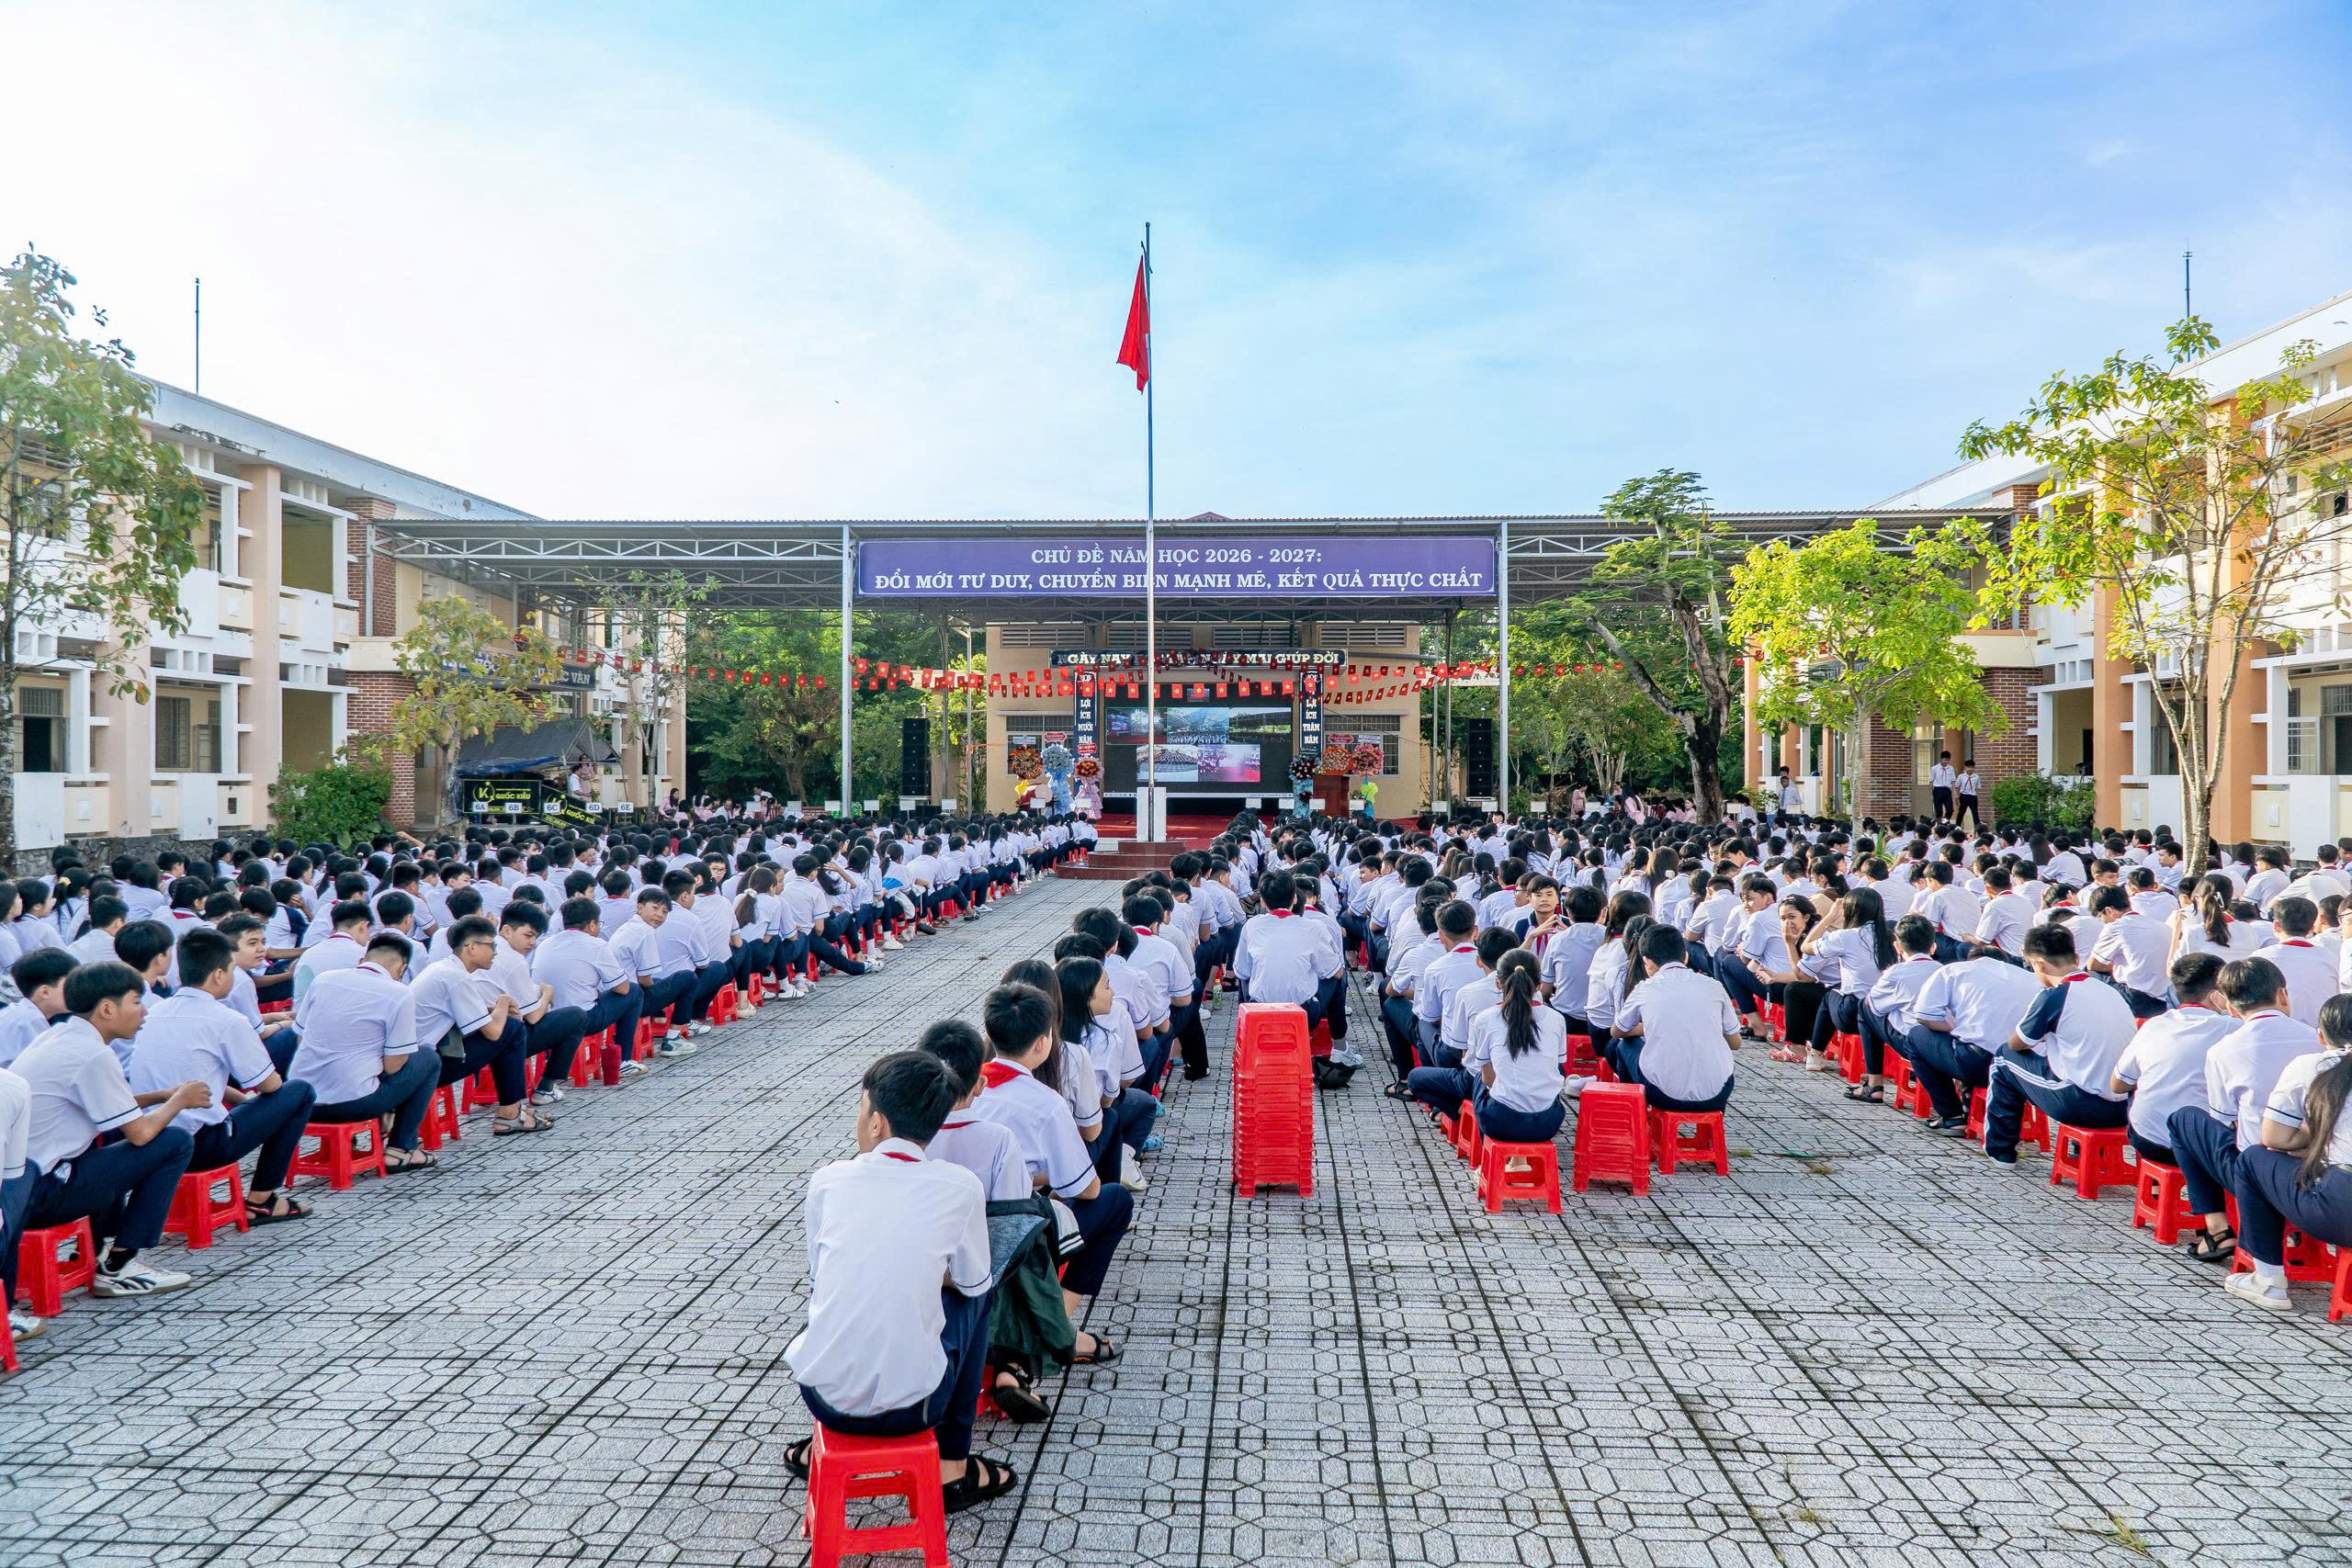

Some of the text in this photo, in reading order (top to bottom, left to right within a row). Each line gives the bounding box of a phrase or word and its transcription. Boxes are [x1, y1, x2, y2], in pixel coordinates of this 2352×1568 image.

[1031, 545, 1071, 563] CHỦ
[1077, 542, 1104, 563] ĐỀ
[1110, 546, 1148, 563] NĂM
[1158, 548, 1199, 567] HỌC
[1205, 548, 1252, 563] 2026
[1270, 548, 1322, 563] 2027:
[875, 568, 910, 589] ĐỔI
[916, 570, 954, 589] MỚI
[958, 572, 986, 589] TƯ
[990, 574, 1033, 591] DUY,
[1038, 568, 1116, 589] CHUYỂN
[1174, 573, 1230, 592] MẠNH
[1237, 570, 1272, 590] MẼ,
[1277, 566, 1317, 588] KẾT
[1322, 569, 1364, 591] QUẢ
[1369, 571, 1423, 592] THỰC
[1429, 565, 1483, 588] CHẤT
[1313, 650, 1339, 664] ĐỜI
[1080, 709, 1091, 719] ÍCH
[1306, 709, 1317, 719] ÍCH
